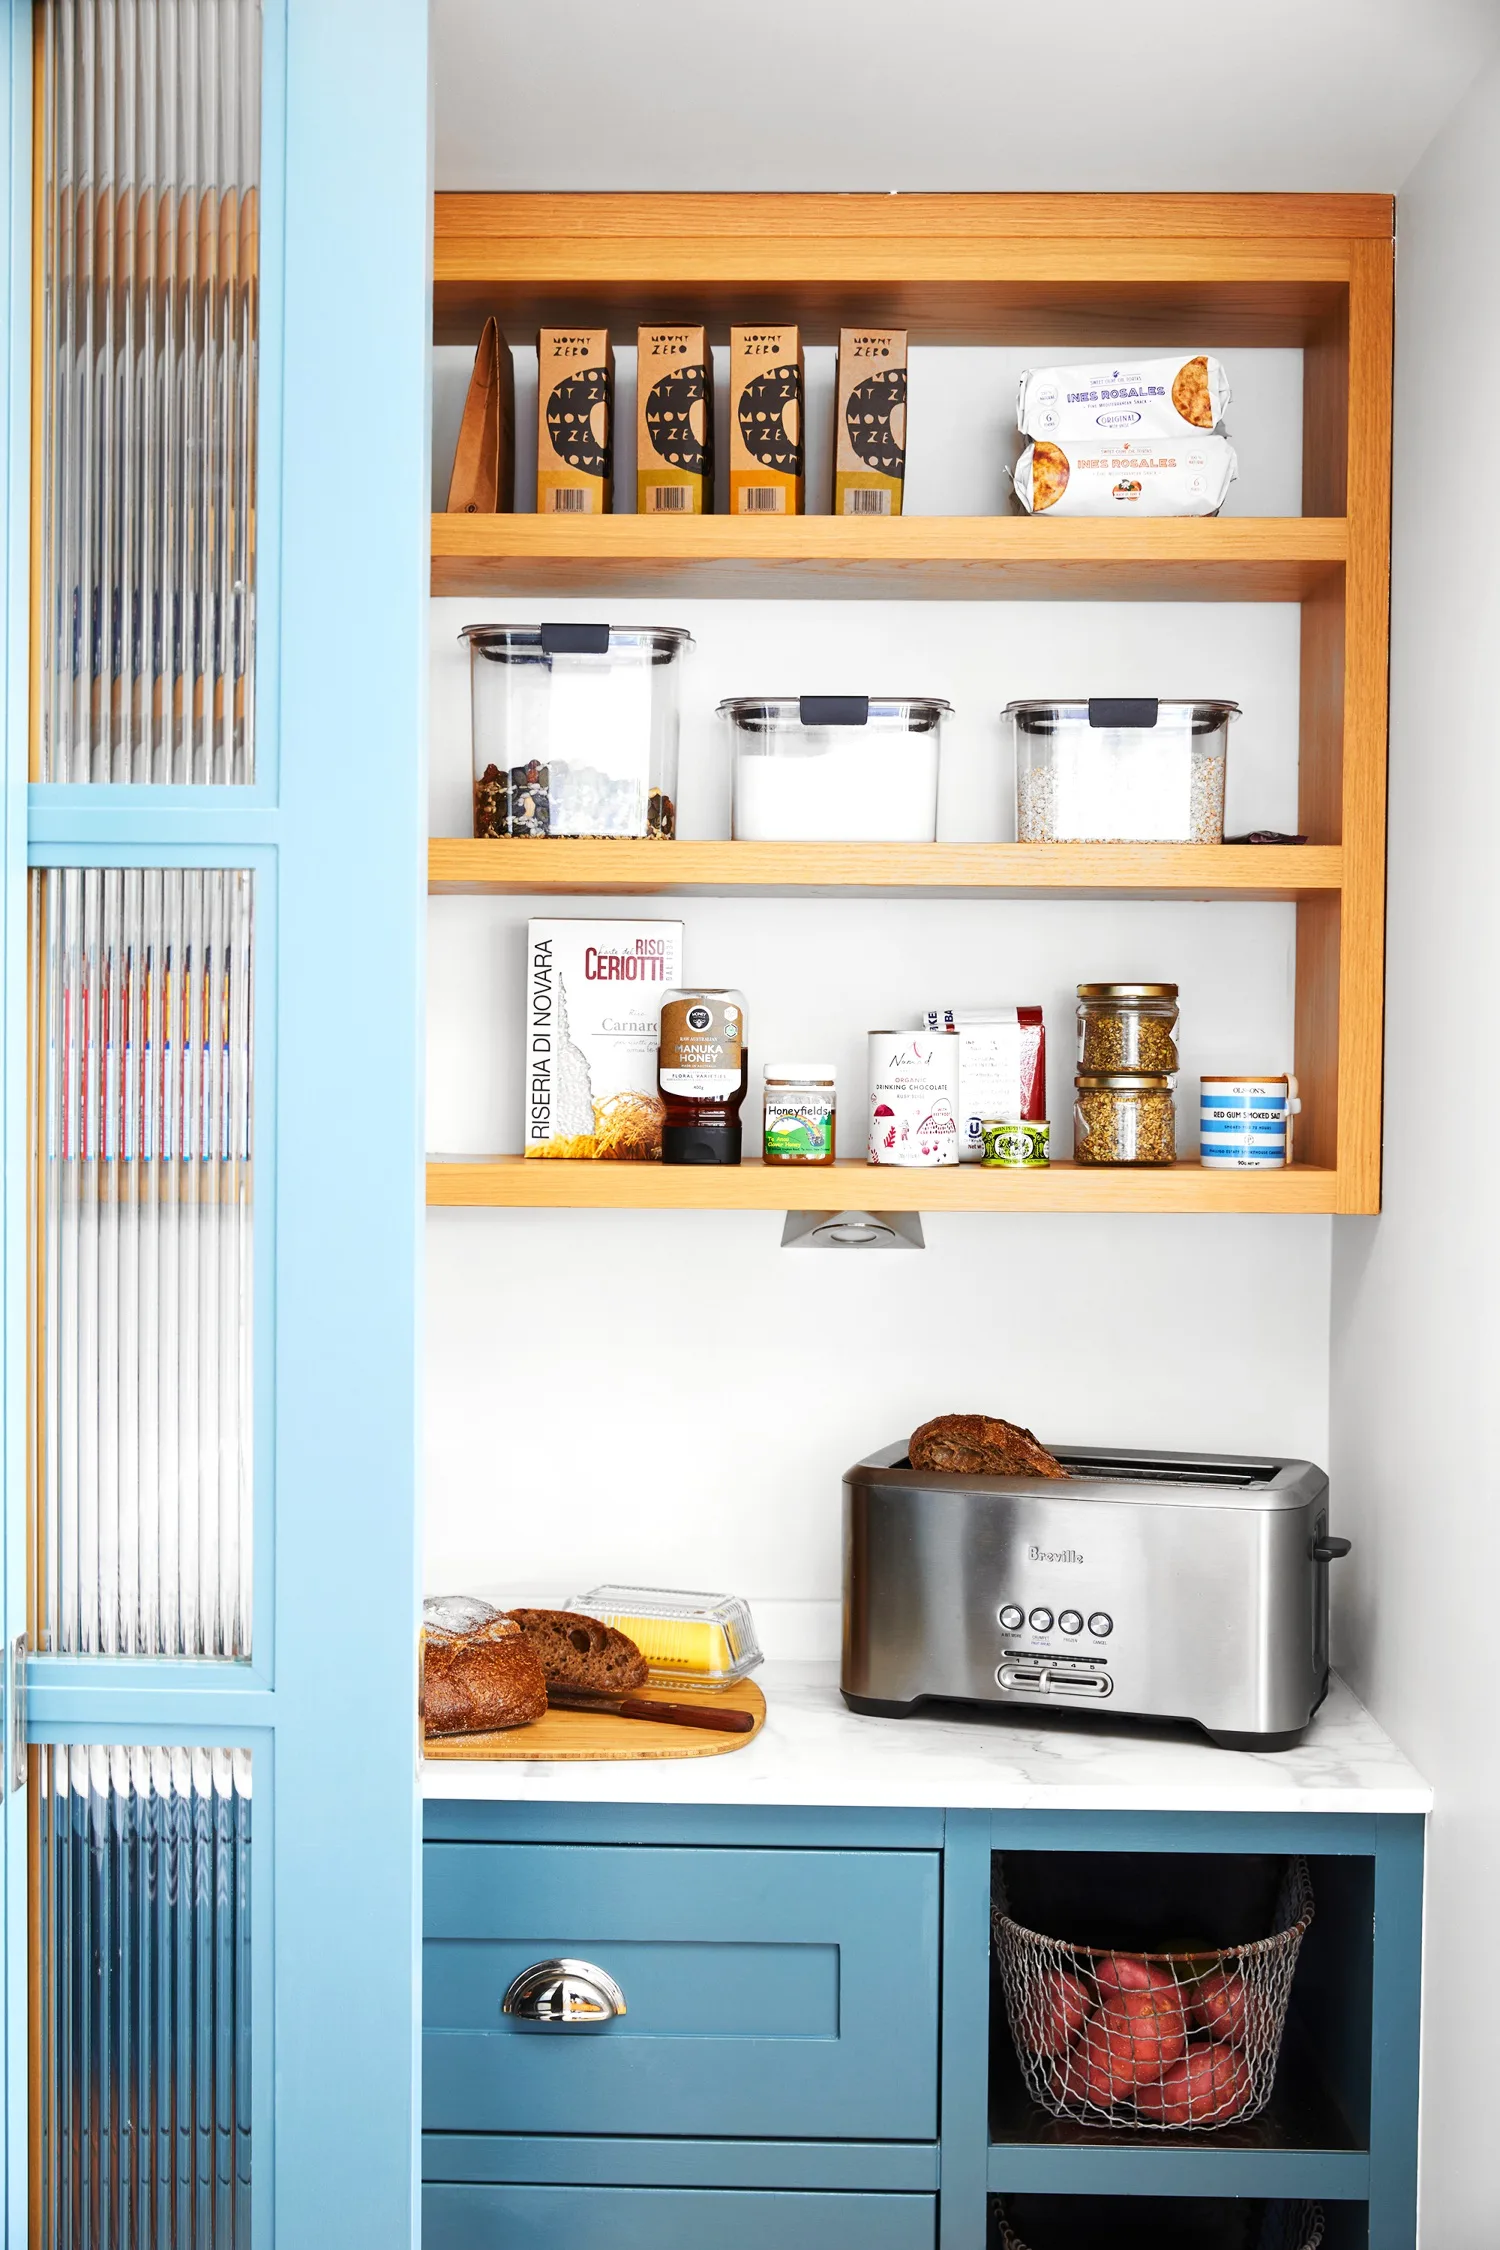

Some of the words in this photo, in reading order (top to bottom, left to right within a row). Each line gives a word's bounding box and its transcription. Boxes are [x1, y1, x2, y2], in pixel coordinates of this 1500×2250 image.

[553, 347, 589, 356] ZERO
[651, 345, 687, 354] ZERO
[744, 345, 780, 354] ZERO
[853, 347, 890, 357] ZERO
[1067, 391, 1099, 403] INES
[1101, 386, 1165, 400] ROSALES
[1101, 414, 1136, 424] ORIGINAL
[1077, 459, 1109, 469] INES
[1112, 458, 1177, 468] ROSALES
[635, 939, 665, 955] RISO
[585, 947, 664, 981] CERIOTTI
[533, 939, 553, 1026] NOVARA
[532, 1033, 551, 1052] DI
[675, 1045, 723, 1053] MANUKA
[680, 1054, 718, 1062] HONEY
[531, 1059, 551, 1139] RISERIA
[768, 1106, 828, 1118] Honeyfields
[1227, 1111, 1241, 1119] GUM
[1029, 1546, 1084, 1564] Breville
